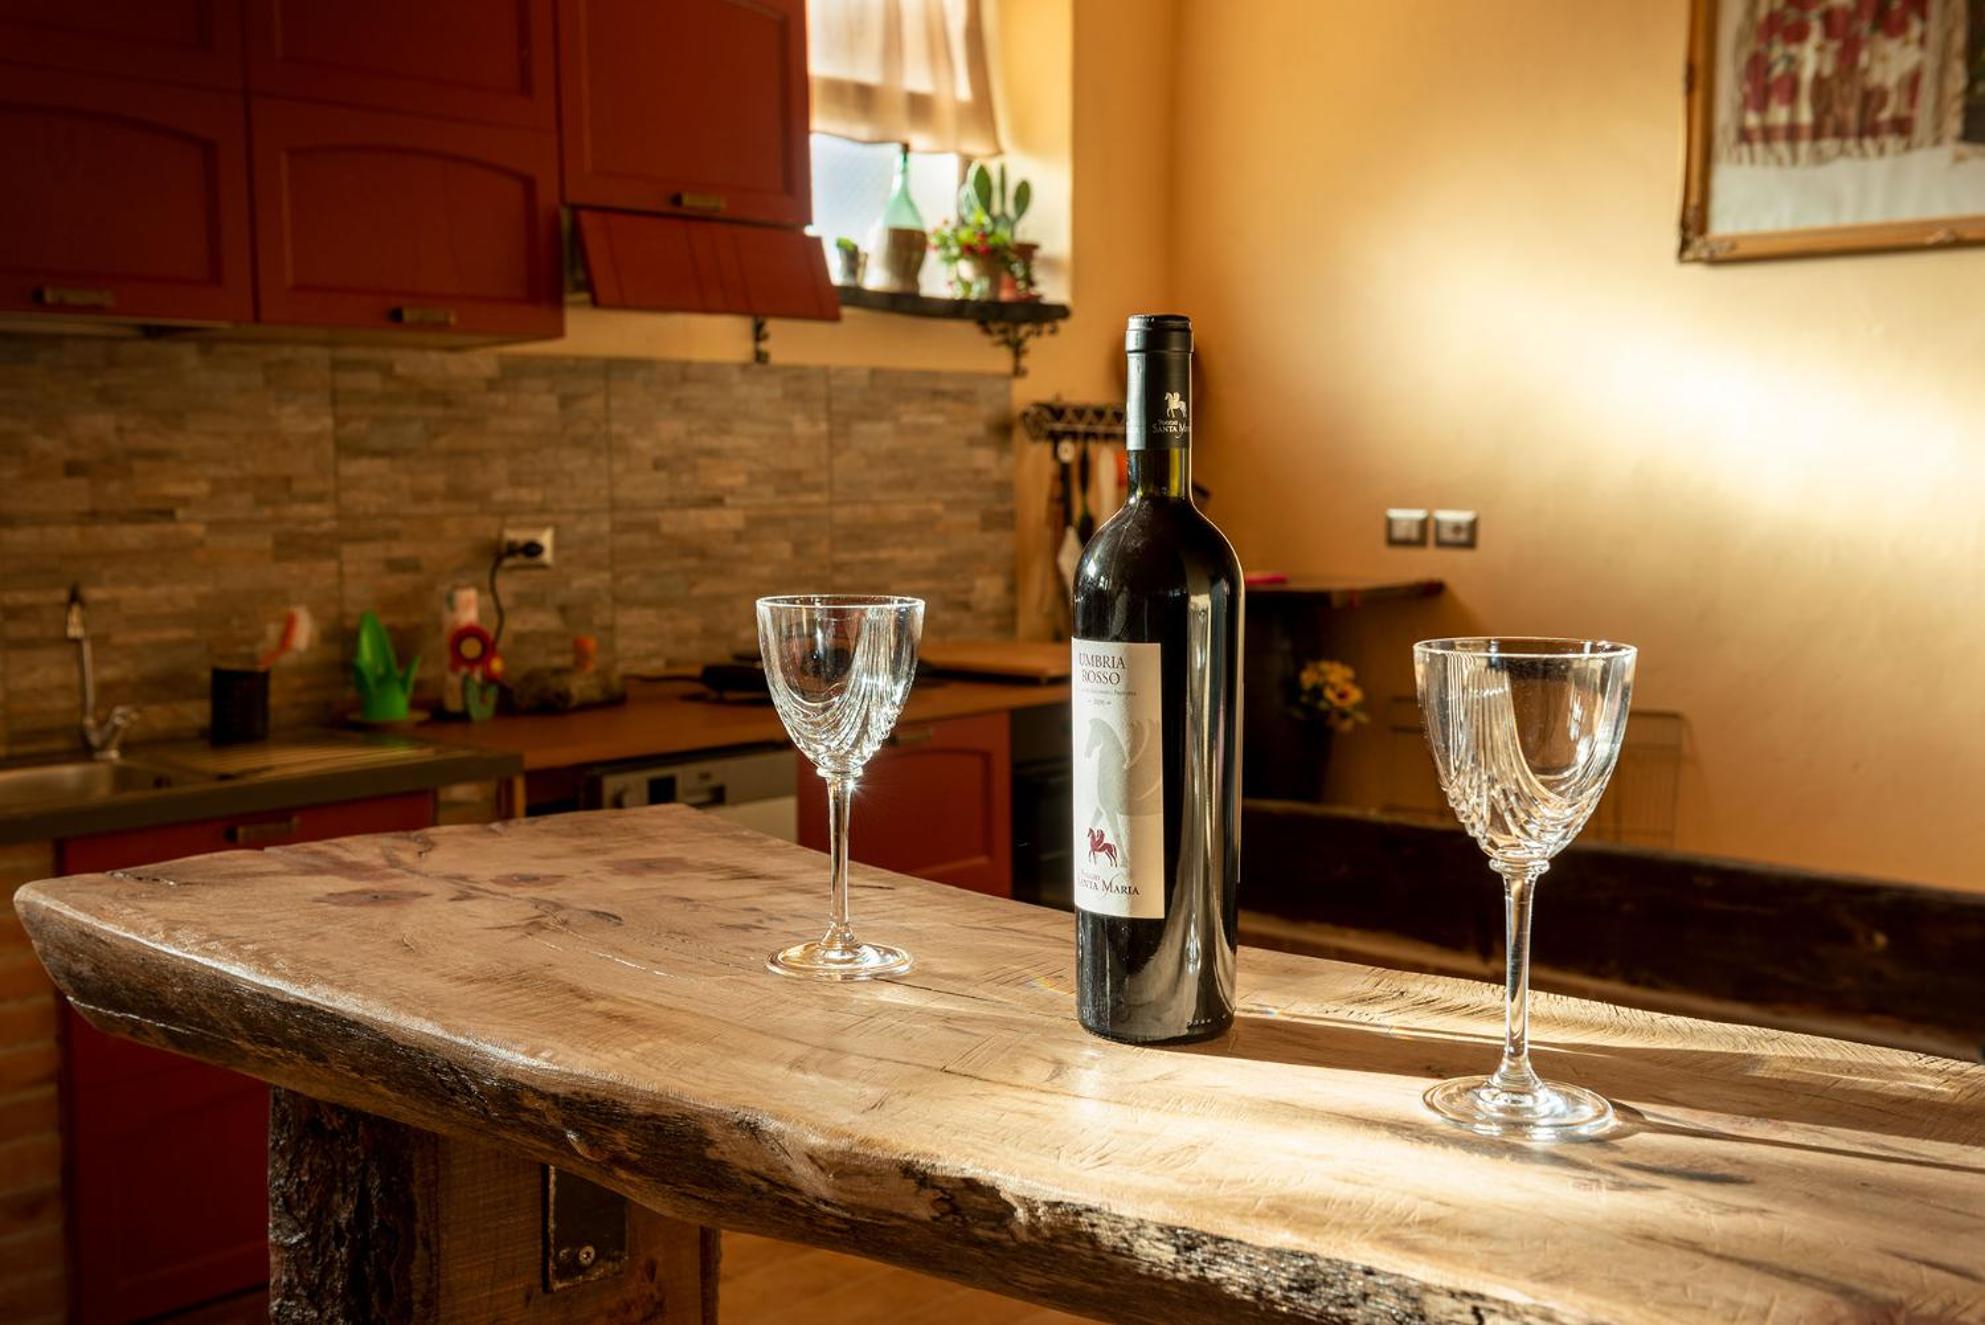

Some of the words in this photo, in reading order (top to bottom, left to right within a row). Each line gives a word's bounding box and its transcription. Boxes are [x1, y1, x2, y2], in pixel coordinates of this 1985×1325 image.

[1079, 652, 1126, 670] UMBRIA
[1081, 669, 1120, 685] ROSSO
[1079, 878, 1099, 890] ANTA
[1101, 876, 1139, 896] MARIA
